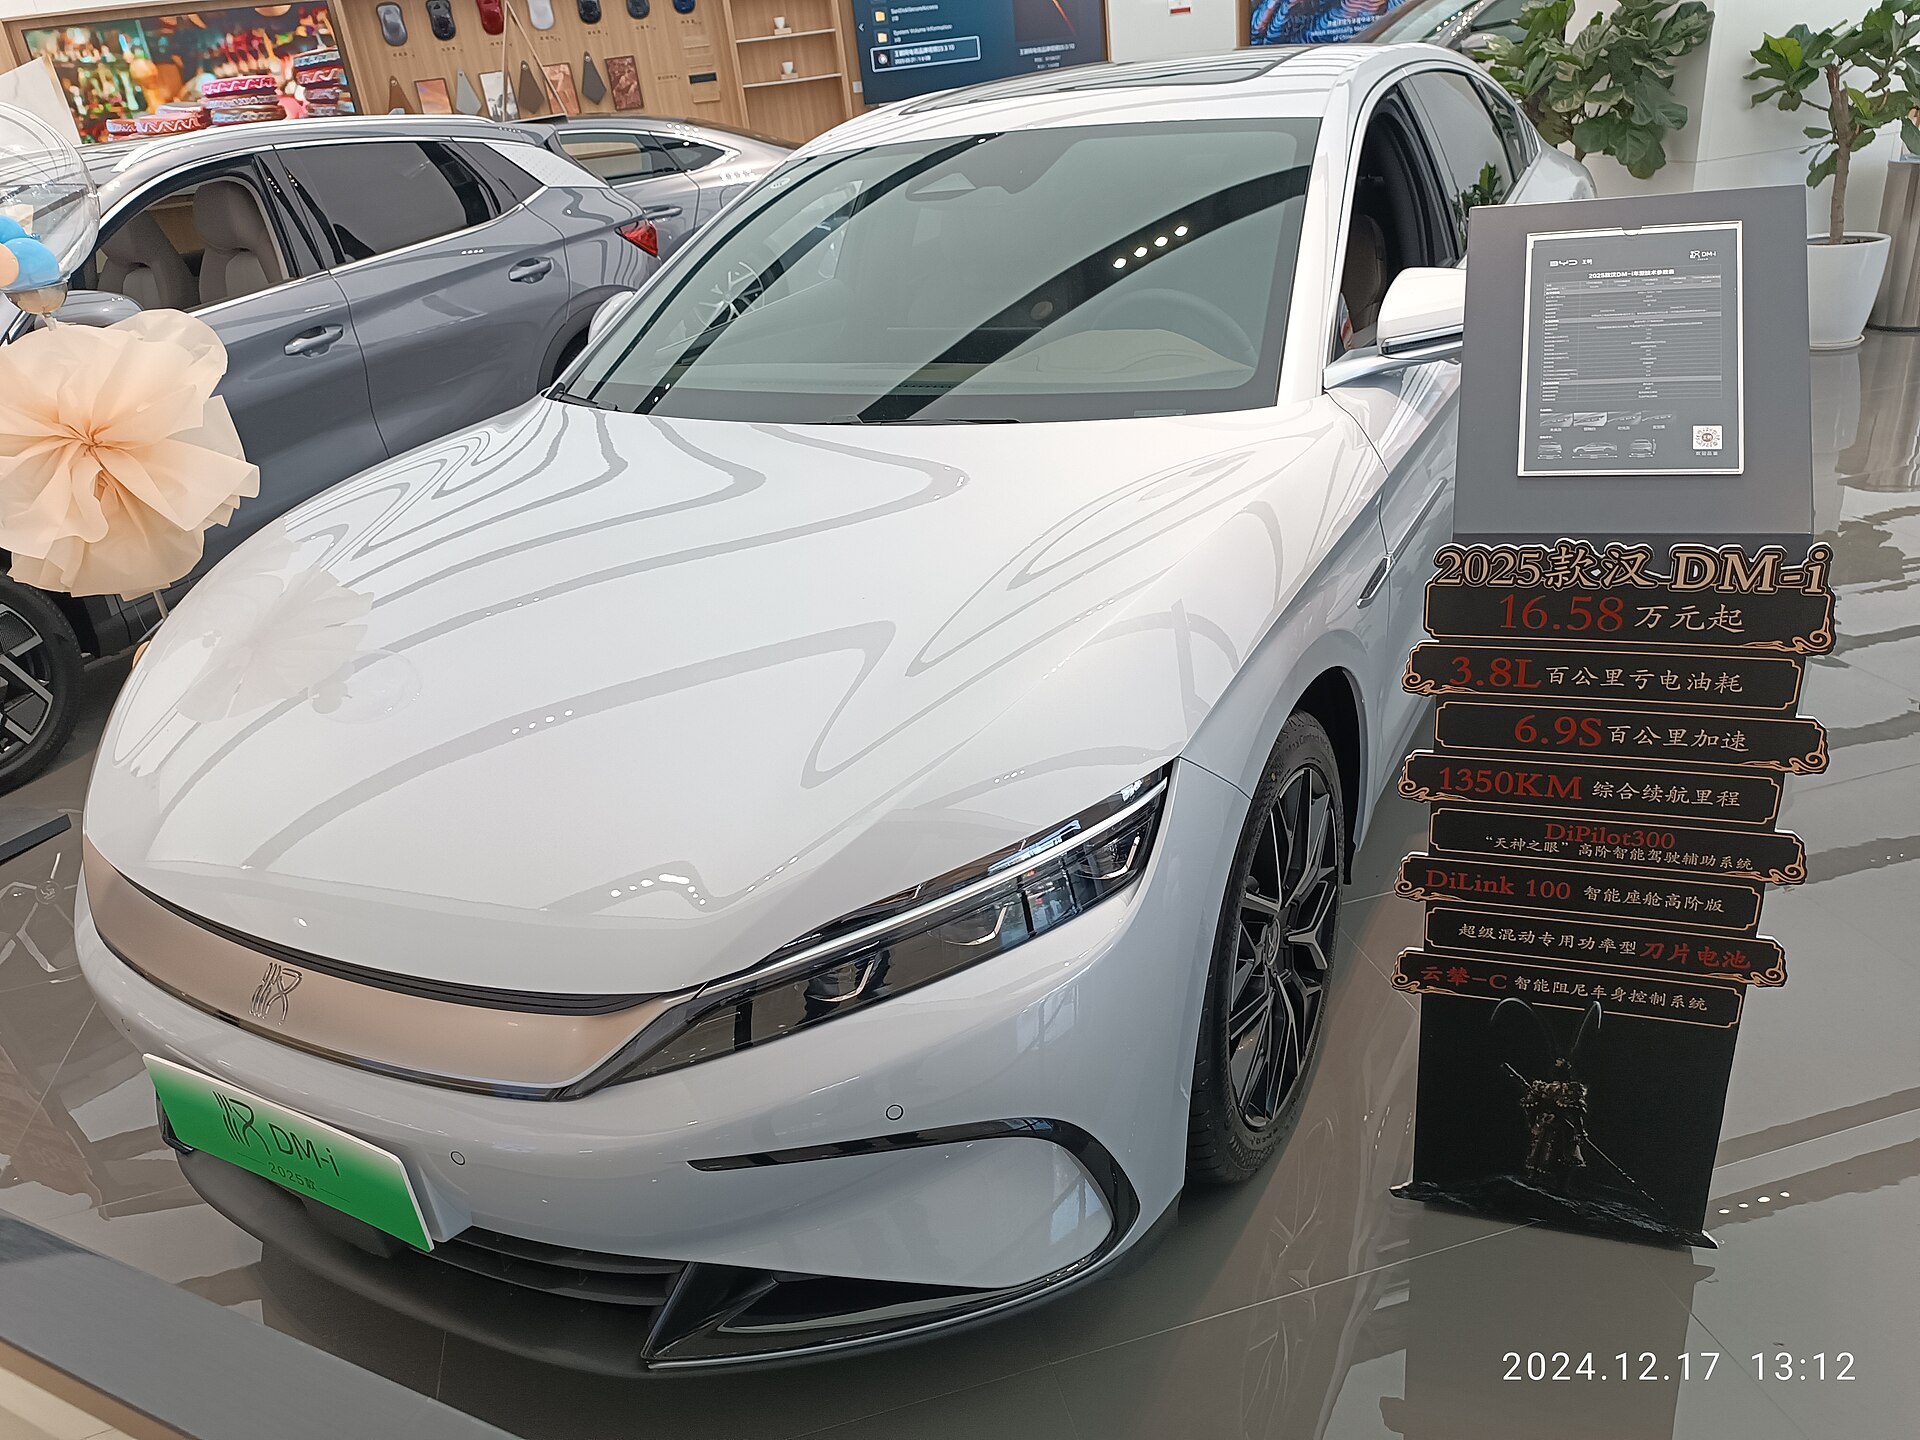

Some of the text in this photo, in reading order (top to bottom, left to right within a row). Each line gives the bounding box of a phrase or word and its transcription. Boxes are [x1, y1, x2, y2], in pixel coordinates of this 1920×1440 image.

[1549, 259, 1578, 267] BYD
[1434, 543, 1830, 596] 2025款汉 DM-i
[1500, 594, 1745, 634] 16.58 万元起
[1450, 656, 1744, 694] 3.8L 百公里亏电油耗
[1514, 715, 1750, 752] 6.9S 百公里加速
[1439, 767, 1742, 808] 1350KM 综合续航里程
[1544, 823, 1676, 849] DiPilot300
[1578, 843, 1754, 871] 高阶智能驾驶辅助系统
[1425, 869, 1725, 914] DiLink 100 智能座舱高阶版
[1514, 975, 1708, 1011] 智能阻尼车身控制系统
[268, 1122, 340, 1177] DM-i
